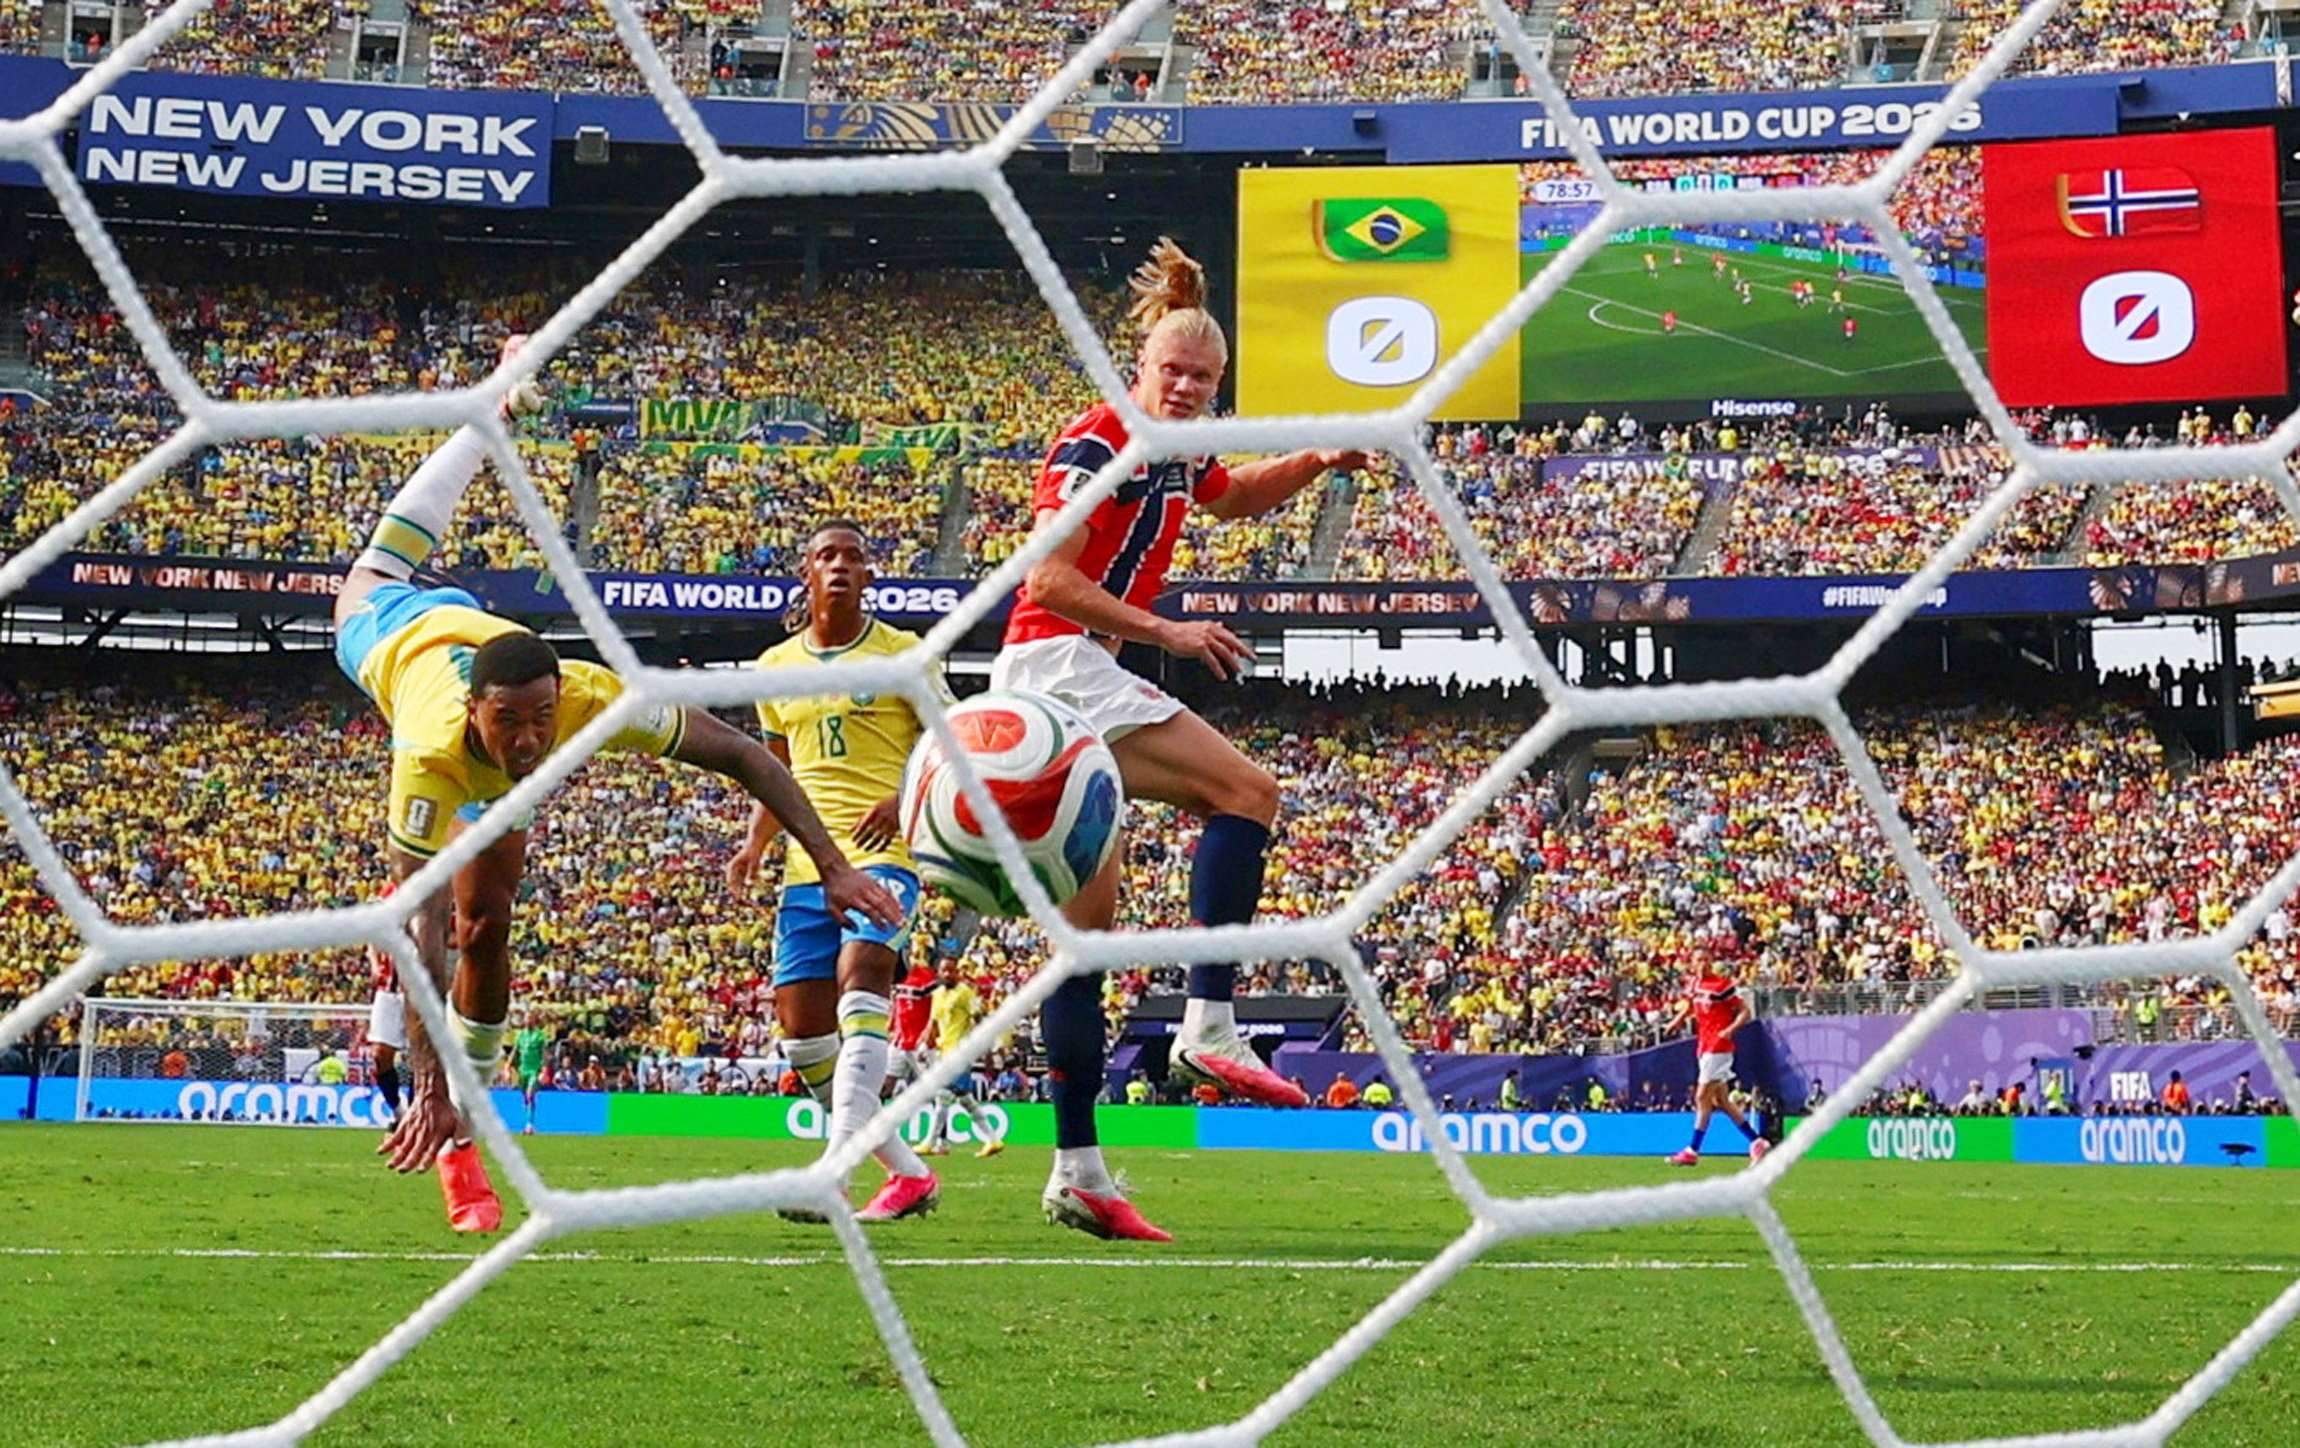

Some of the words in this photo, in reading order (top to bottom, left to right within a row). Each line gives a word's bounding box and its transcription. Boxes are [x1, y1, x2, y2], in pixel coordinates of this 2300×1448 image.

[90, 95, 286, 143] NEW
[305, 106, 537, 157] YORK
[1608, 110, 1750, 145] WORLD
[1756, 108, 1836, 139] CUP
[86, 148, 247, 188] NEW
[261, 159, 535, 203] JERSEY
[1547, 183, 1593, 199] 78:57
[1712, 400, 1796, 416] Hisense
[73, 563, 132, 585] NEW
[214, 569, 272, 592] NEW
[277, 573, 347, 595] JERS
[603, 581, 669, 608] FIFA
[673, 583, 783, 609] WORLD
[861, 587, 960, 612] 2026
[1182, 592, 1238, 613] NEW
[1318, 592, 1376, 613] NEW
[1380, 592, 1478, 613] JERSEY
[816, 715, 847, 759] 18
[2110, 1071, 2153, 1101] FIFA
[786, 1098, 1009, 1143] amco
[1867, 1117, 1956, 1160] aramco
[2080, 1117, 2186, 1163] aramco
